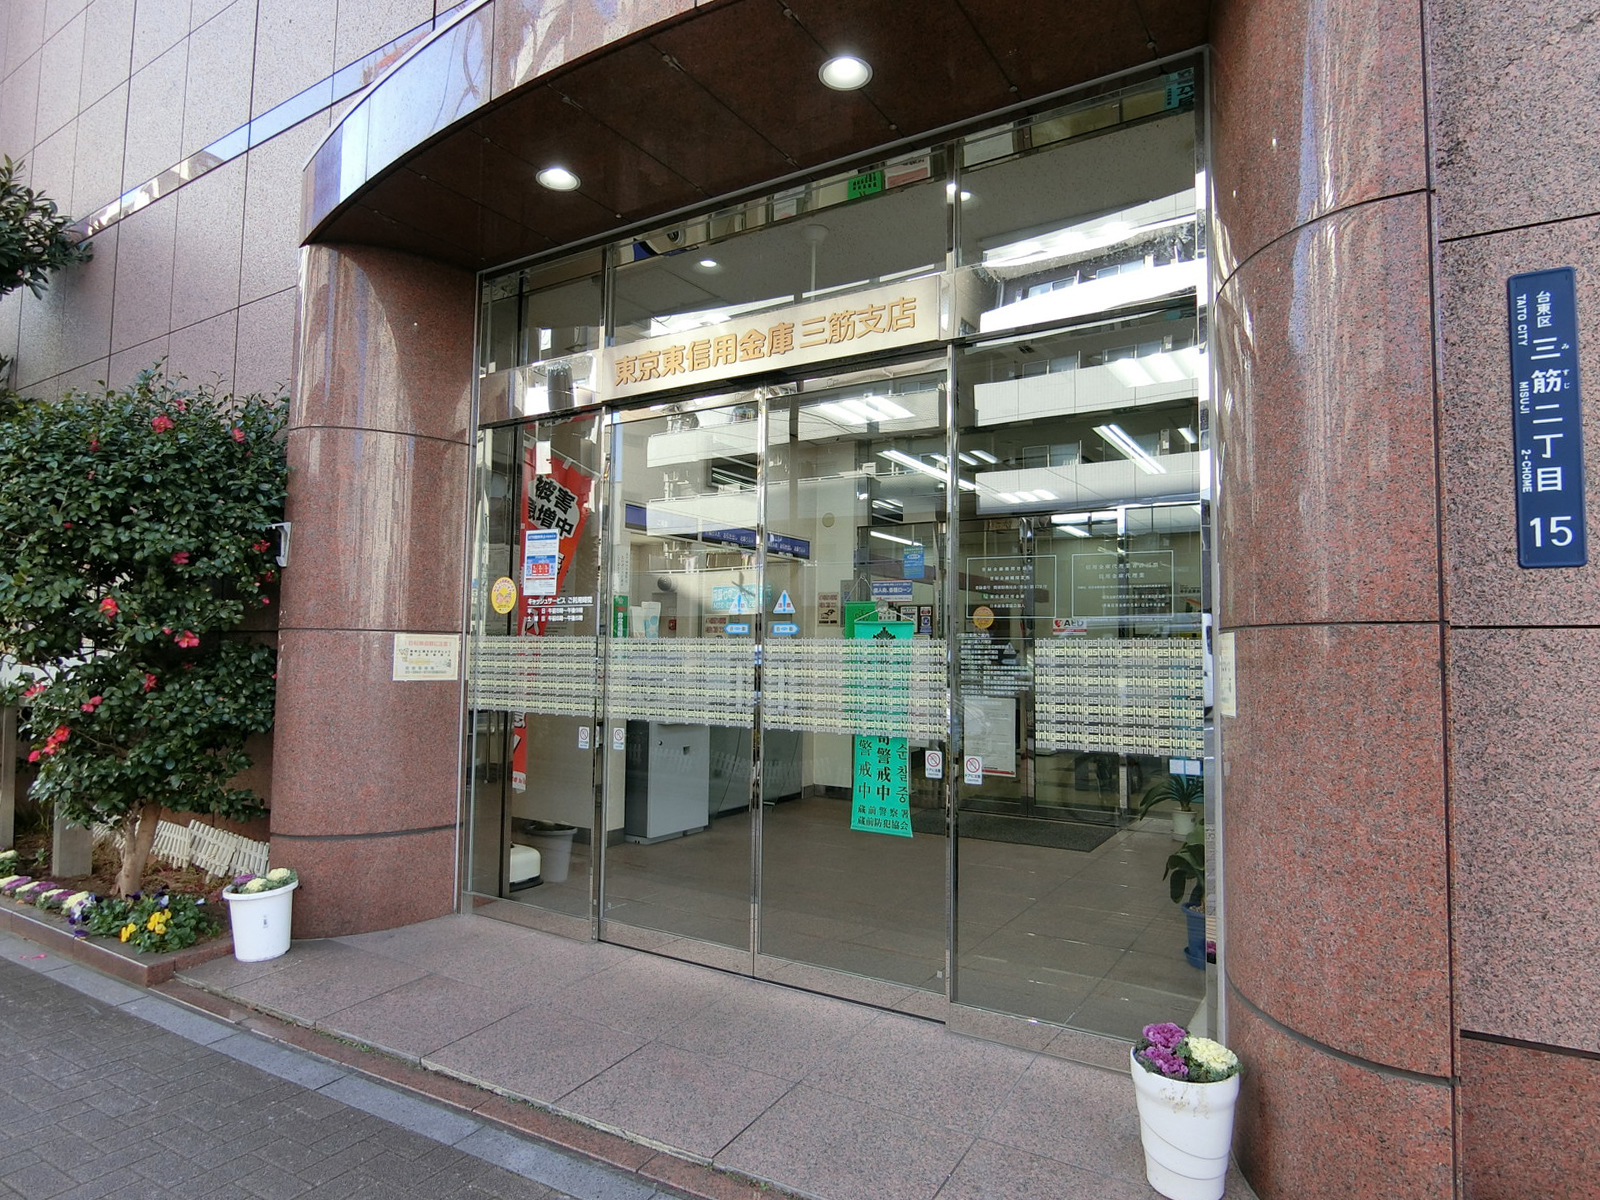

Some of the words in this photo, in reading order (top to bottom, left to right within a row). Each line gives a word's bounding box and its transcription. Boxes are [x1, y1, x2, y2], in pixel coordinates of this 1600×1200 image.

[1516, 293, 1527, 321] TAITO
[1535, 290, 1552, 328] 台東区
[613, 321, 796, 386] 東京東信用金庫
[799, 296, 917, 349] 三筋支店
[1517, 324, 1529, 346] CITY
[1519, 381, 1531, 414] MISUJI
[1530, 336, 1564, 492] 三筋二丁目
[1521, 449, 1533, 493] 2-CHOME
[535, 474, 576, 515] 被害
[1529, 515, 1573, 547] 15
[858, 739, 873, 799] 警戒中
[895, 743, 909, 803] 순찰중
[857, 804, 910, 819] 蔵前警察署
[857, 815, 909, 831] 蔵前防犯協会
